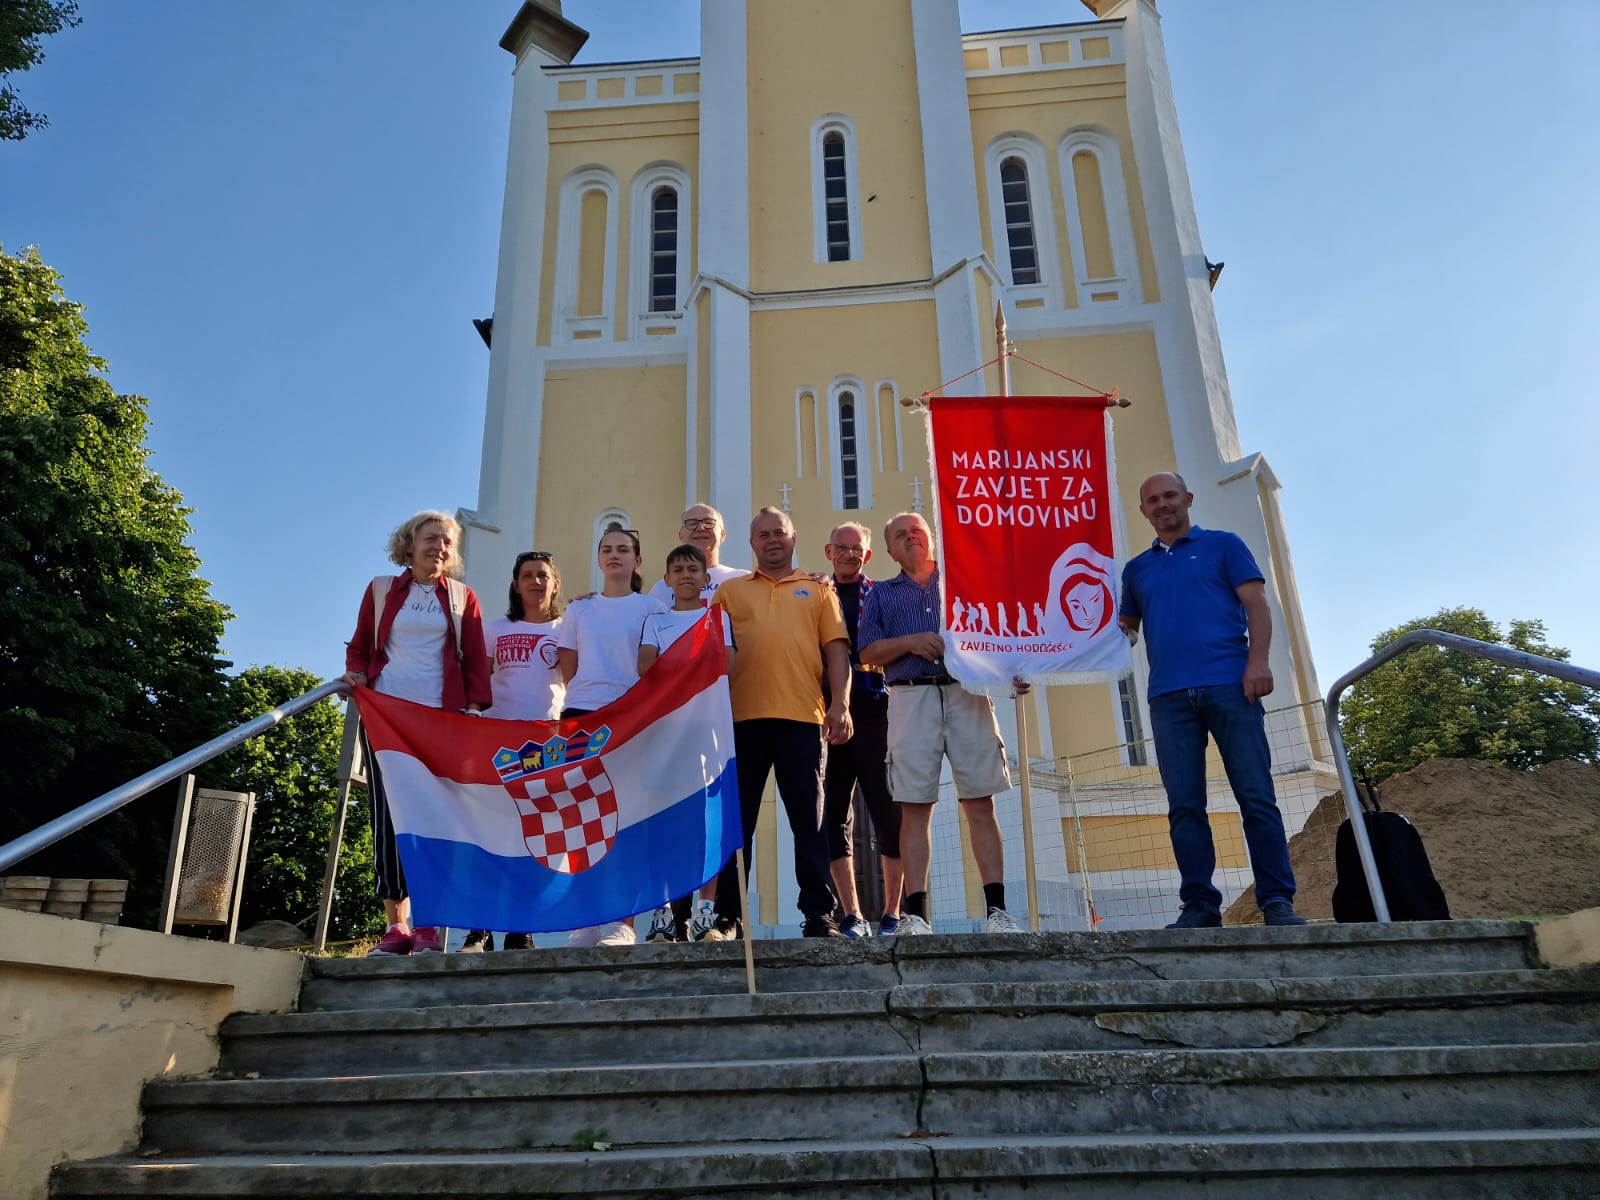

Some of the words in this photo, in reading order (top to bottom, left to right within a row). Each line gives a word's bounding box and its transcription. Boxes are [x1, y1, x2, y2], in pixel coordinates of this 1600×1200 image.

[952, 449, 1091, 470] MARIJANSKI
[955, 474, 1050, 499] ZAVJET
[1061, 476, 1094, 500] ZA
[957, 498, 1096, 528] DOMOVINU
[960, 640, 1012, 653] ZAVJETNO
